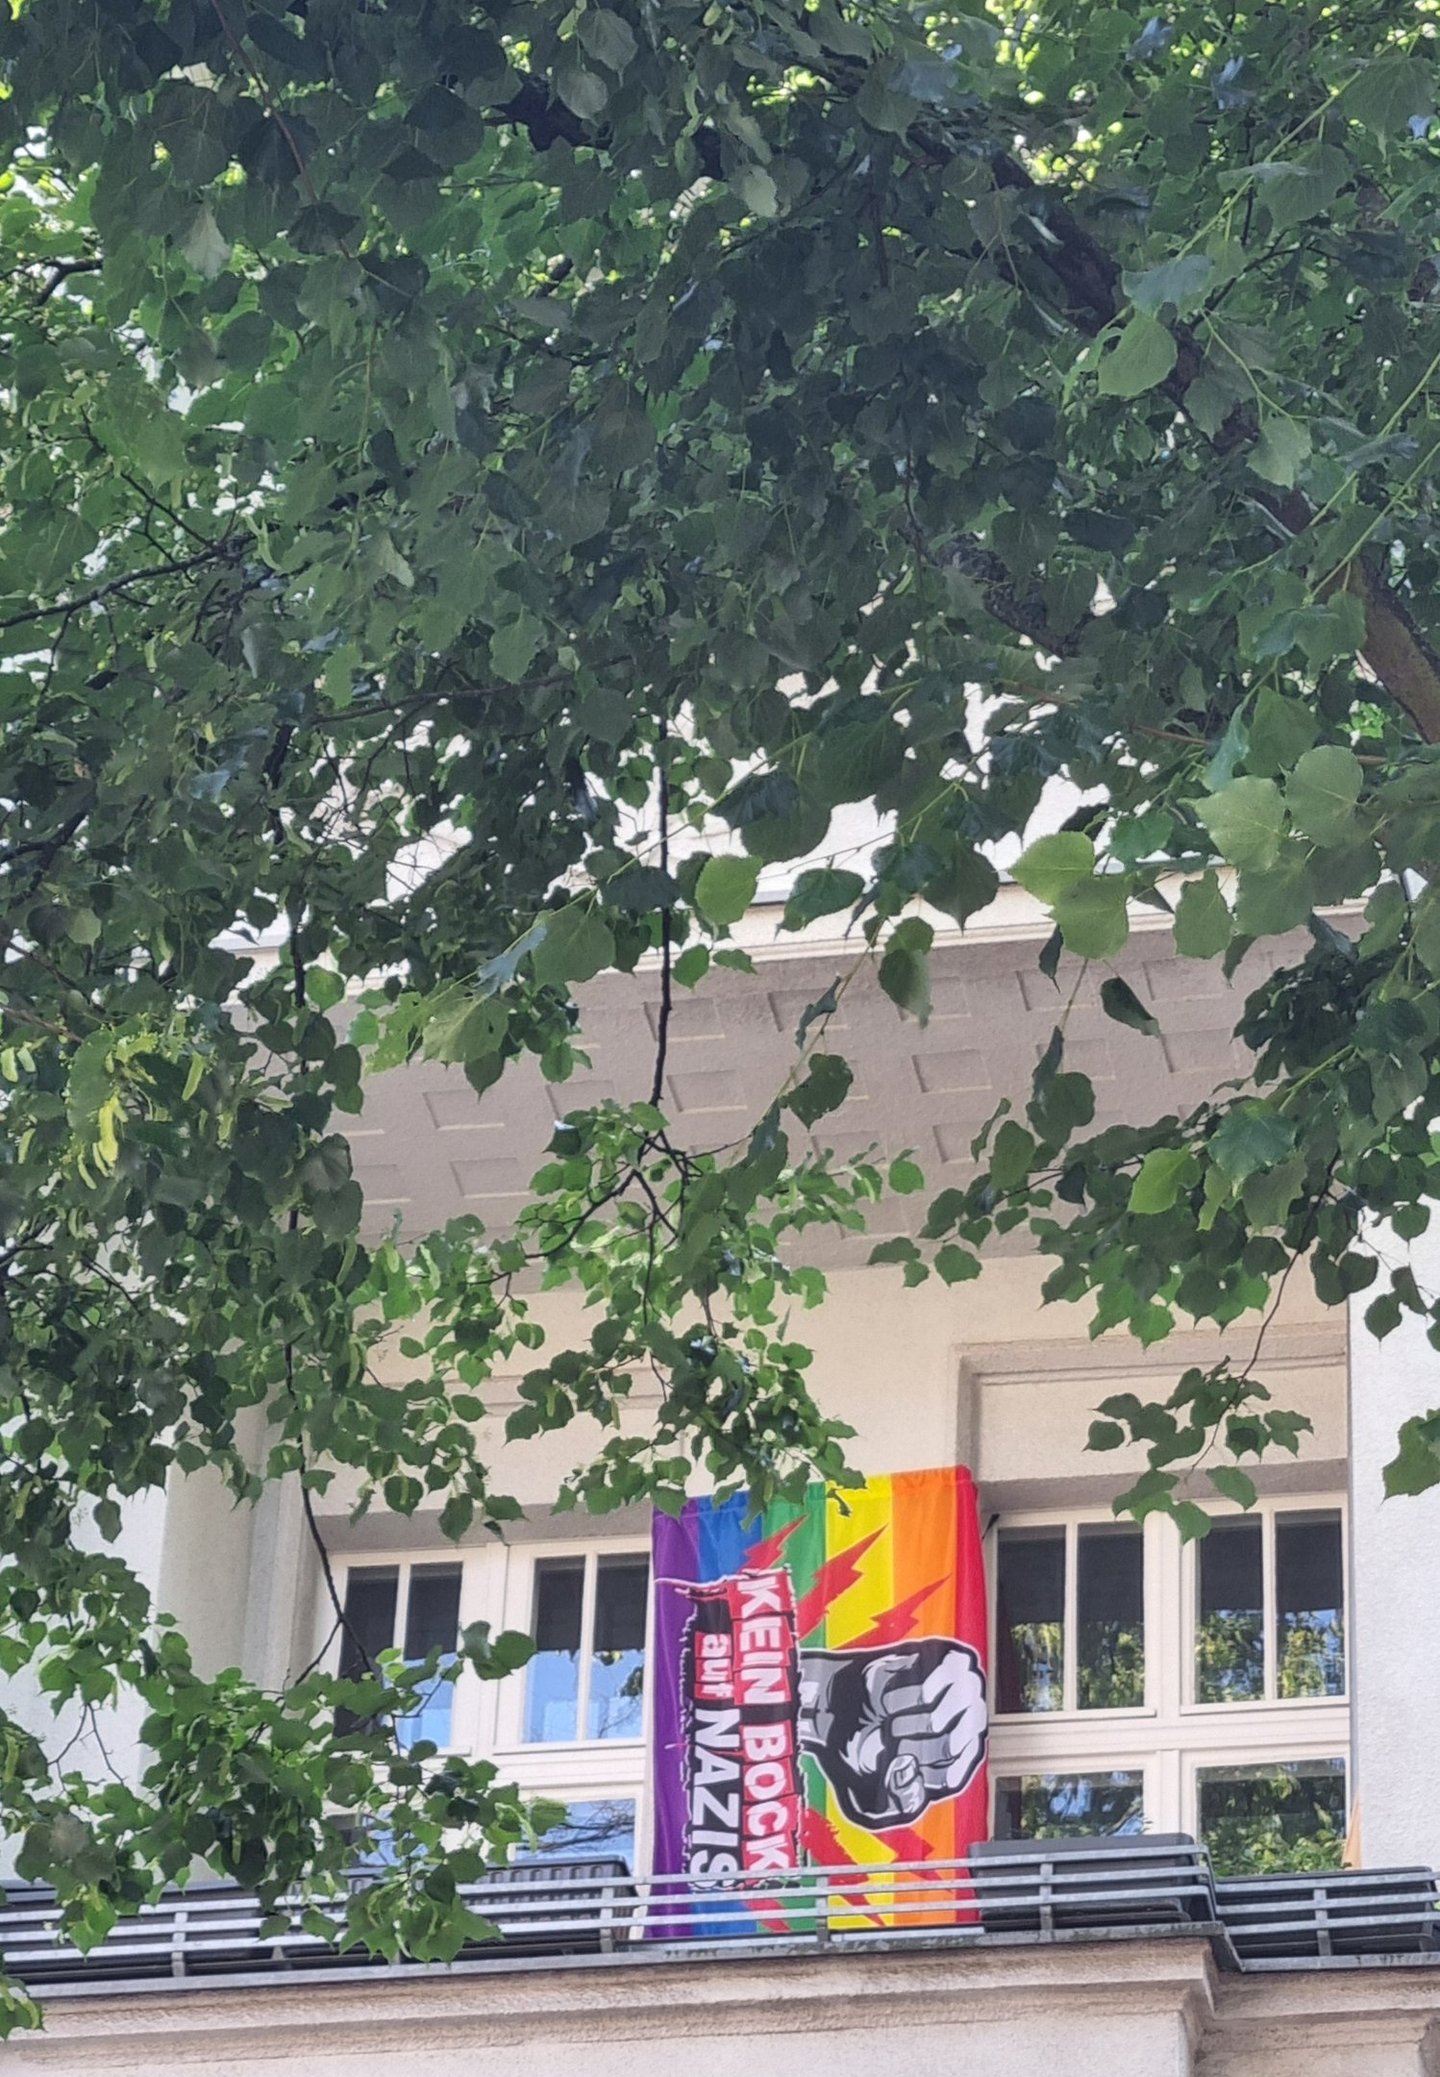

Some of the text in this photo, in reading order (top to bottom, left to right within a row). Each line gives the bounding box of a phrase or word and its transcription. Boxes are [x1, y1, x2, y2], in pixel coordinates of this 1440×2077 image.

[690, 1633, 740, 1888] auf NAZIS
[737, 1576, 789, 1876] KEIN BOCK
